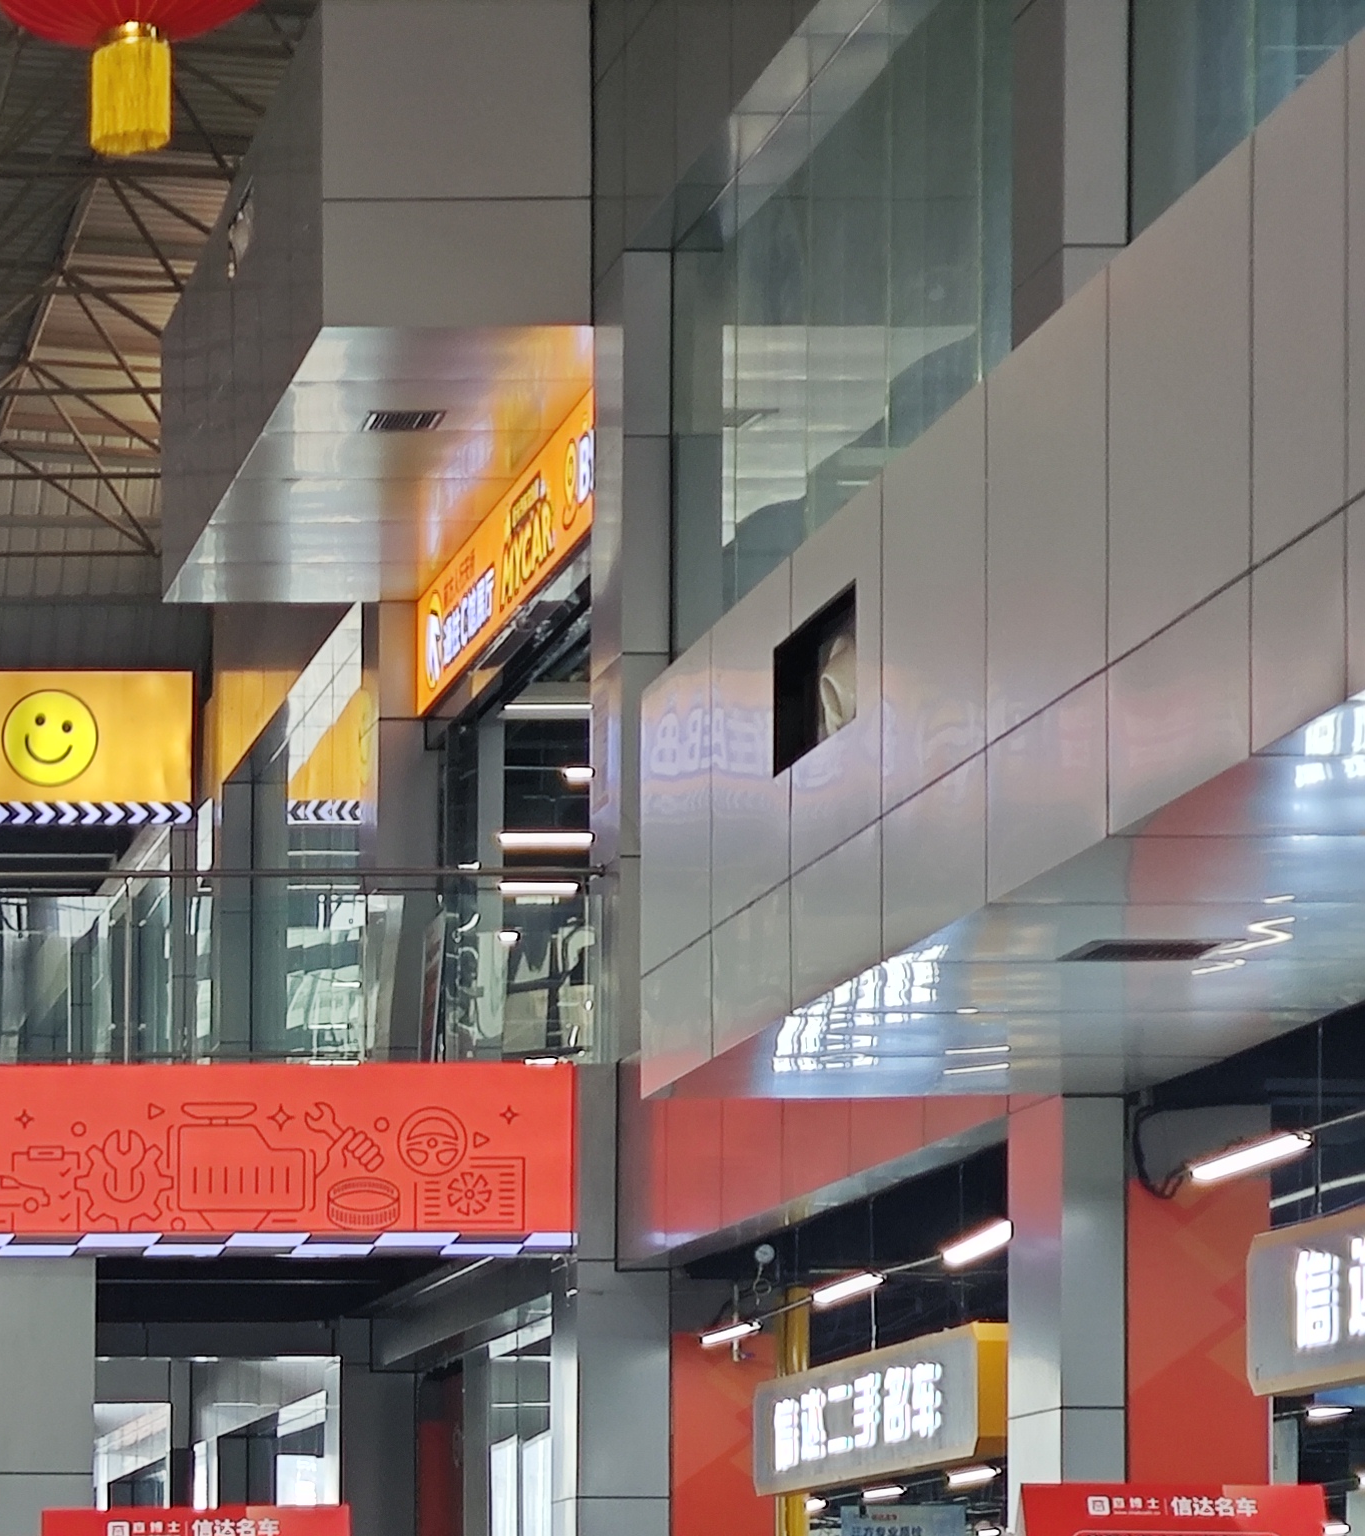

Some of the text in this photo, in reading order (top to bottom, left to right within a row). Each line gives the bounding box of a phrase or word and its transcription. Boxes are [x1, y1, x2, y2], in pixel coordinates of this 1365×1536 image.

[500, 500, 555, 613] MYCAR
[1295, 1237, 1365, 1350] 信
[1171, 1495, 1259, 1518] 信达名车
